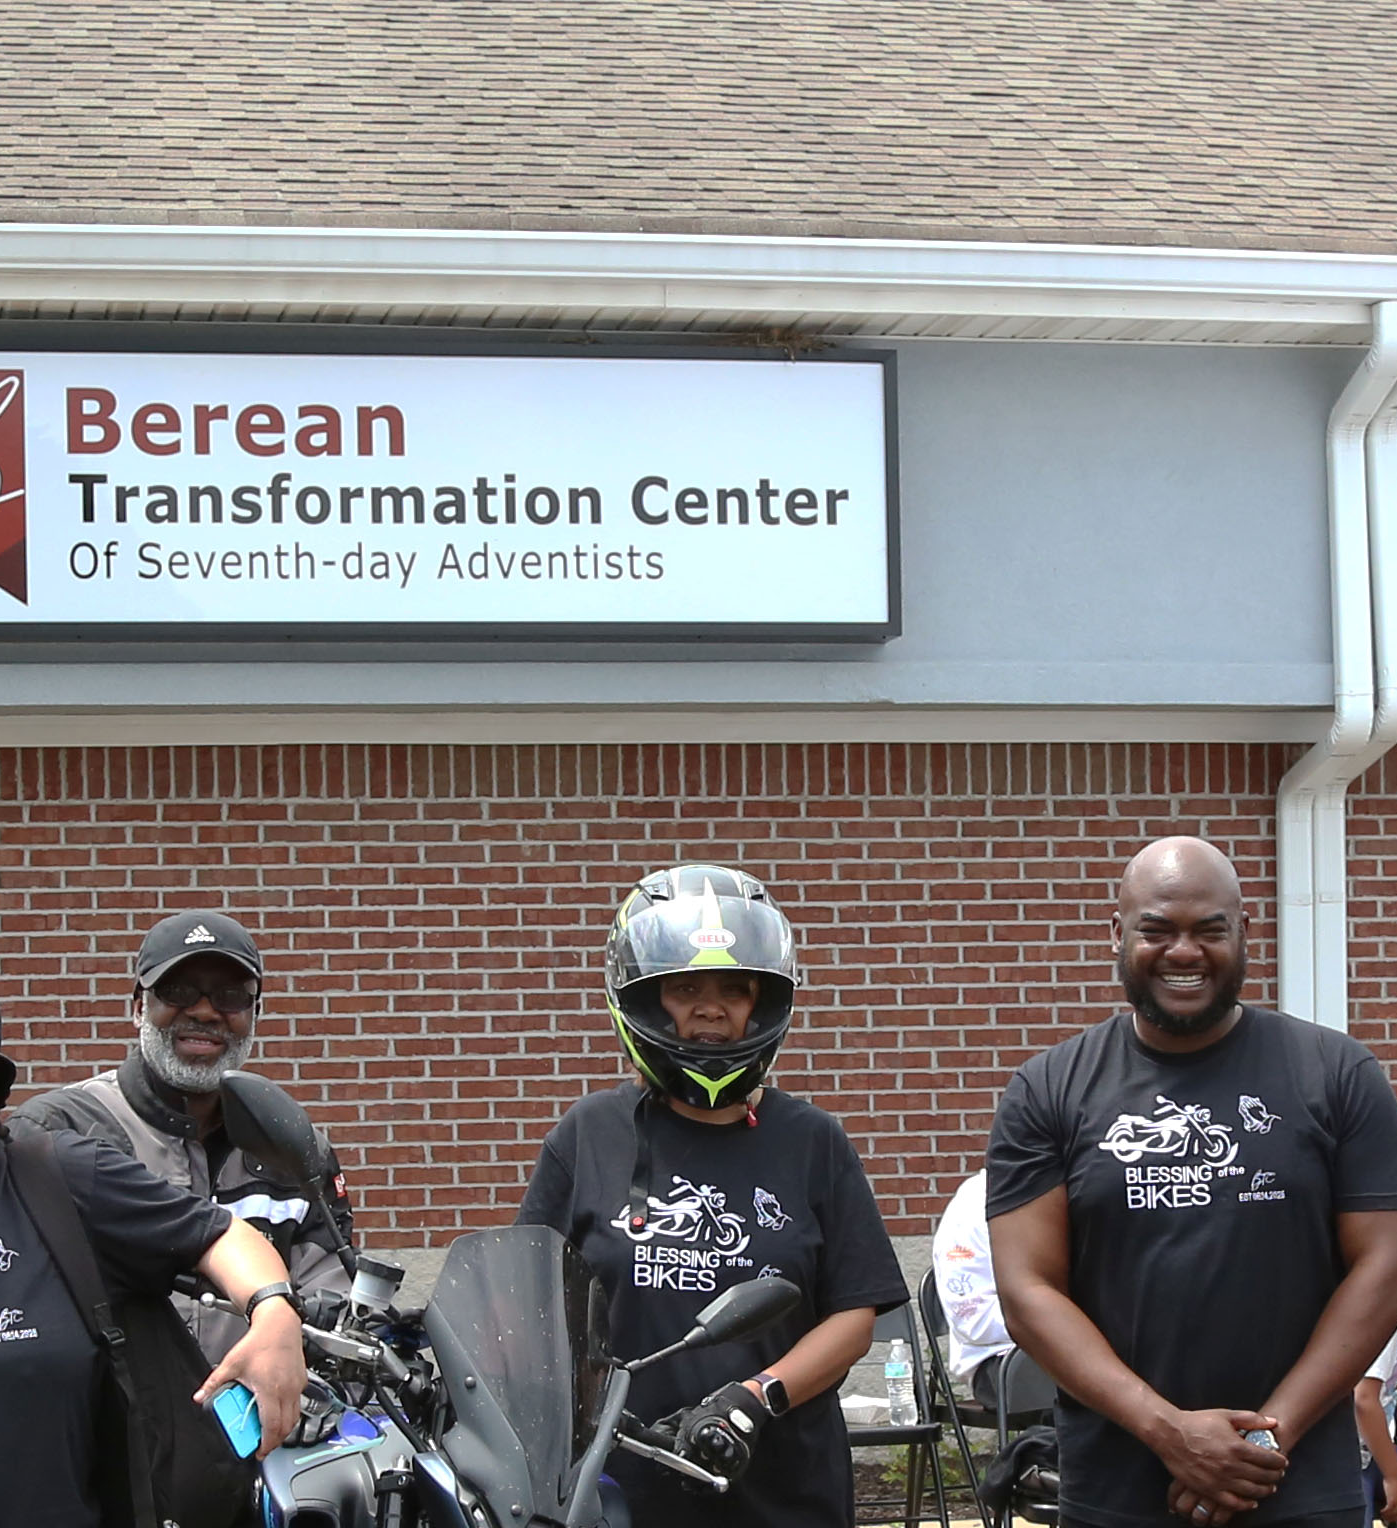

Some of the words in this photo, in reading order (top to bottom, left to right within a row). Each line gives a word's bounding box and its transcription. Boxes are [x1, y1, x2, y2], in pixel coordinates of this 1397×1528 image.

[66, 387, 407, 460] Berean
[68, 472, 604, 527] Transformation
[631, 475, 851, 528] Center
[69, 541, 120, 582] Of
[138, 541, 419, 590] Seventh-day
[438, 542, 666, 582] Adventists
[184, 935, 215, 945] adidas
[697, 934, 729, 945] BELL
[1125, 1165, 1212, 1185] BLESSING
[1217, 1167, 1230, 1178] of
[1230, 1166, 1245, 1176] the
[1126, 1183, 1212, 1210] BIKES
[634, 1245, 720, 1269] BLESSING
[725, 1256, 737, 1267] of
[737, 1257, 753, 1268] the
[633, 1264, 717, 1292] BIKES
